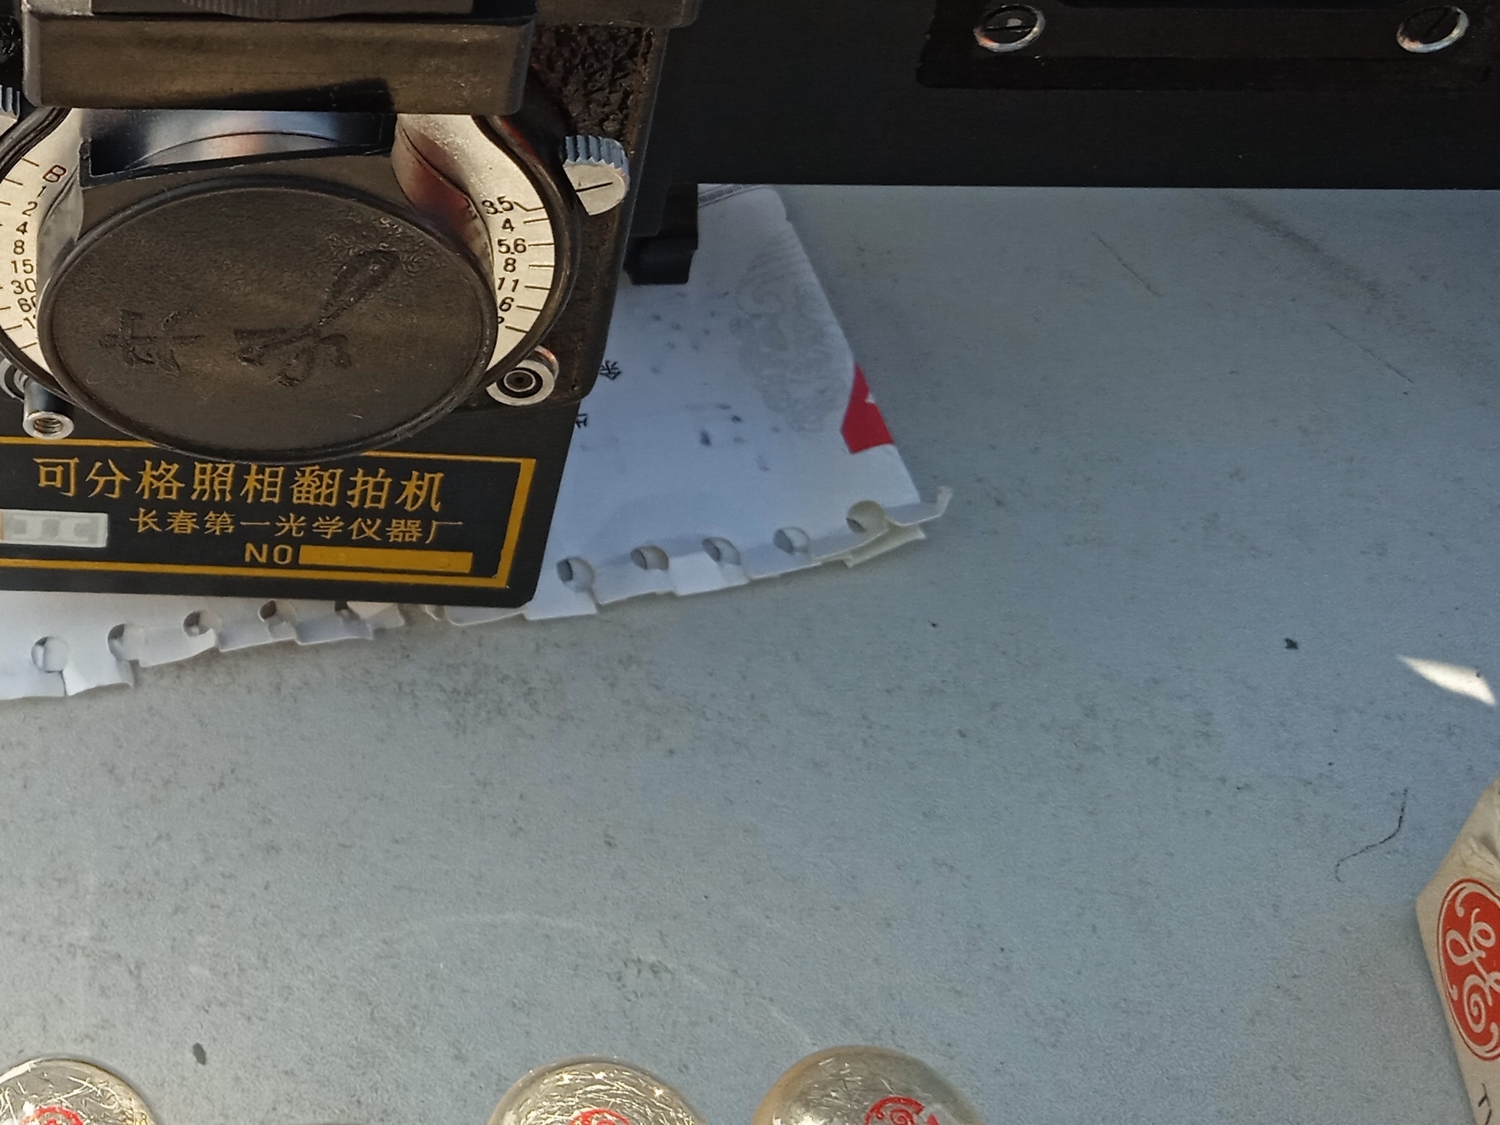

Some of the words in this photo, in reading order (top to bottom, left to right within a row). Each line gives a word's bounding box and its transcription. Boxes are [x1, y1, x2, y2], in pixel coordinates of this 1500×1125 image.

[42, 164, 67, 183] B
[36, 186, 47, 198] 1
[22, 201, 38, 216] 2
[15, 221, 28, 235] 4
[501, 218, 515, 233] 4
[13, 239, 25, 255] 8
[497, 238, 527, 255] 5.6
[10, 259, 34, 274] 15
[503, 257, 516, 273] 8
[11, 278, 37, 295] 30
[497, 277, 520, 293] 11
[33, 457, 443, 513] 可分格照相翻拍机
[129, 507, 464, 544] 长春第一光学仪器厂
